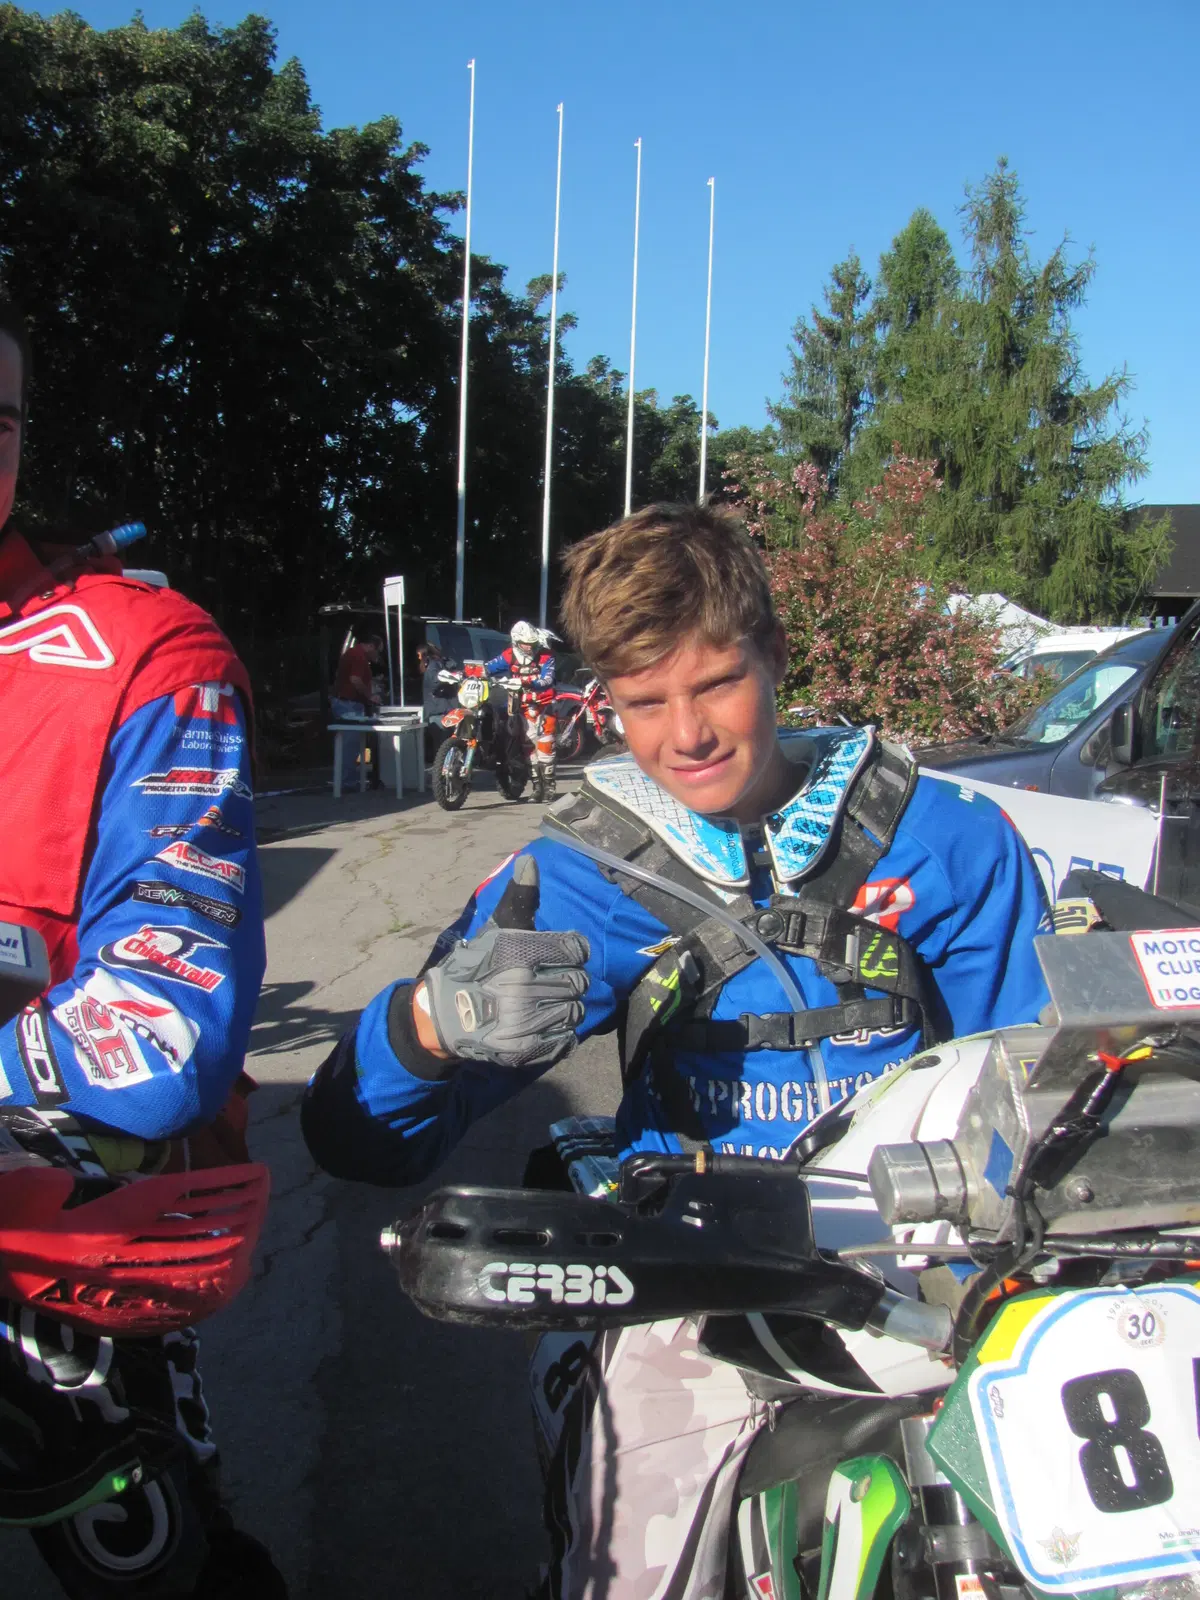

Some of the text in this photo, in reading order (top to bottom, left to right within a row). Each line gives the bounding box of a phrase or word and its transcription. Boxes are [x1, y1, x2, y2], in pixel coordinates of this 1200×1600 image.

[182, 741, 239, 753] Laboraories
[726, 831, 741, 875] moveobra
[123, 937, 222, 991] Chiaravalli
[1128, 1311, 1156, 1340] 30
[1061, 1357, 1200, 1513] 8
